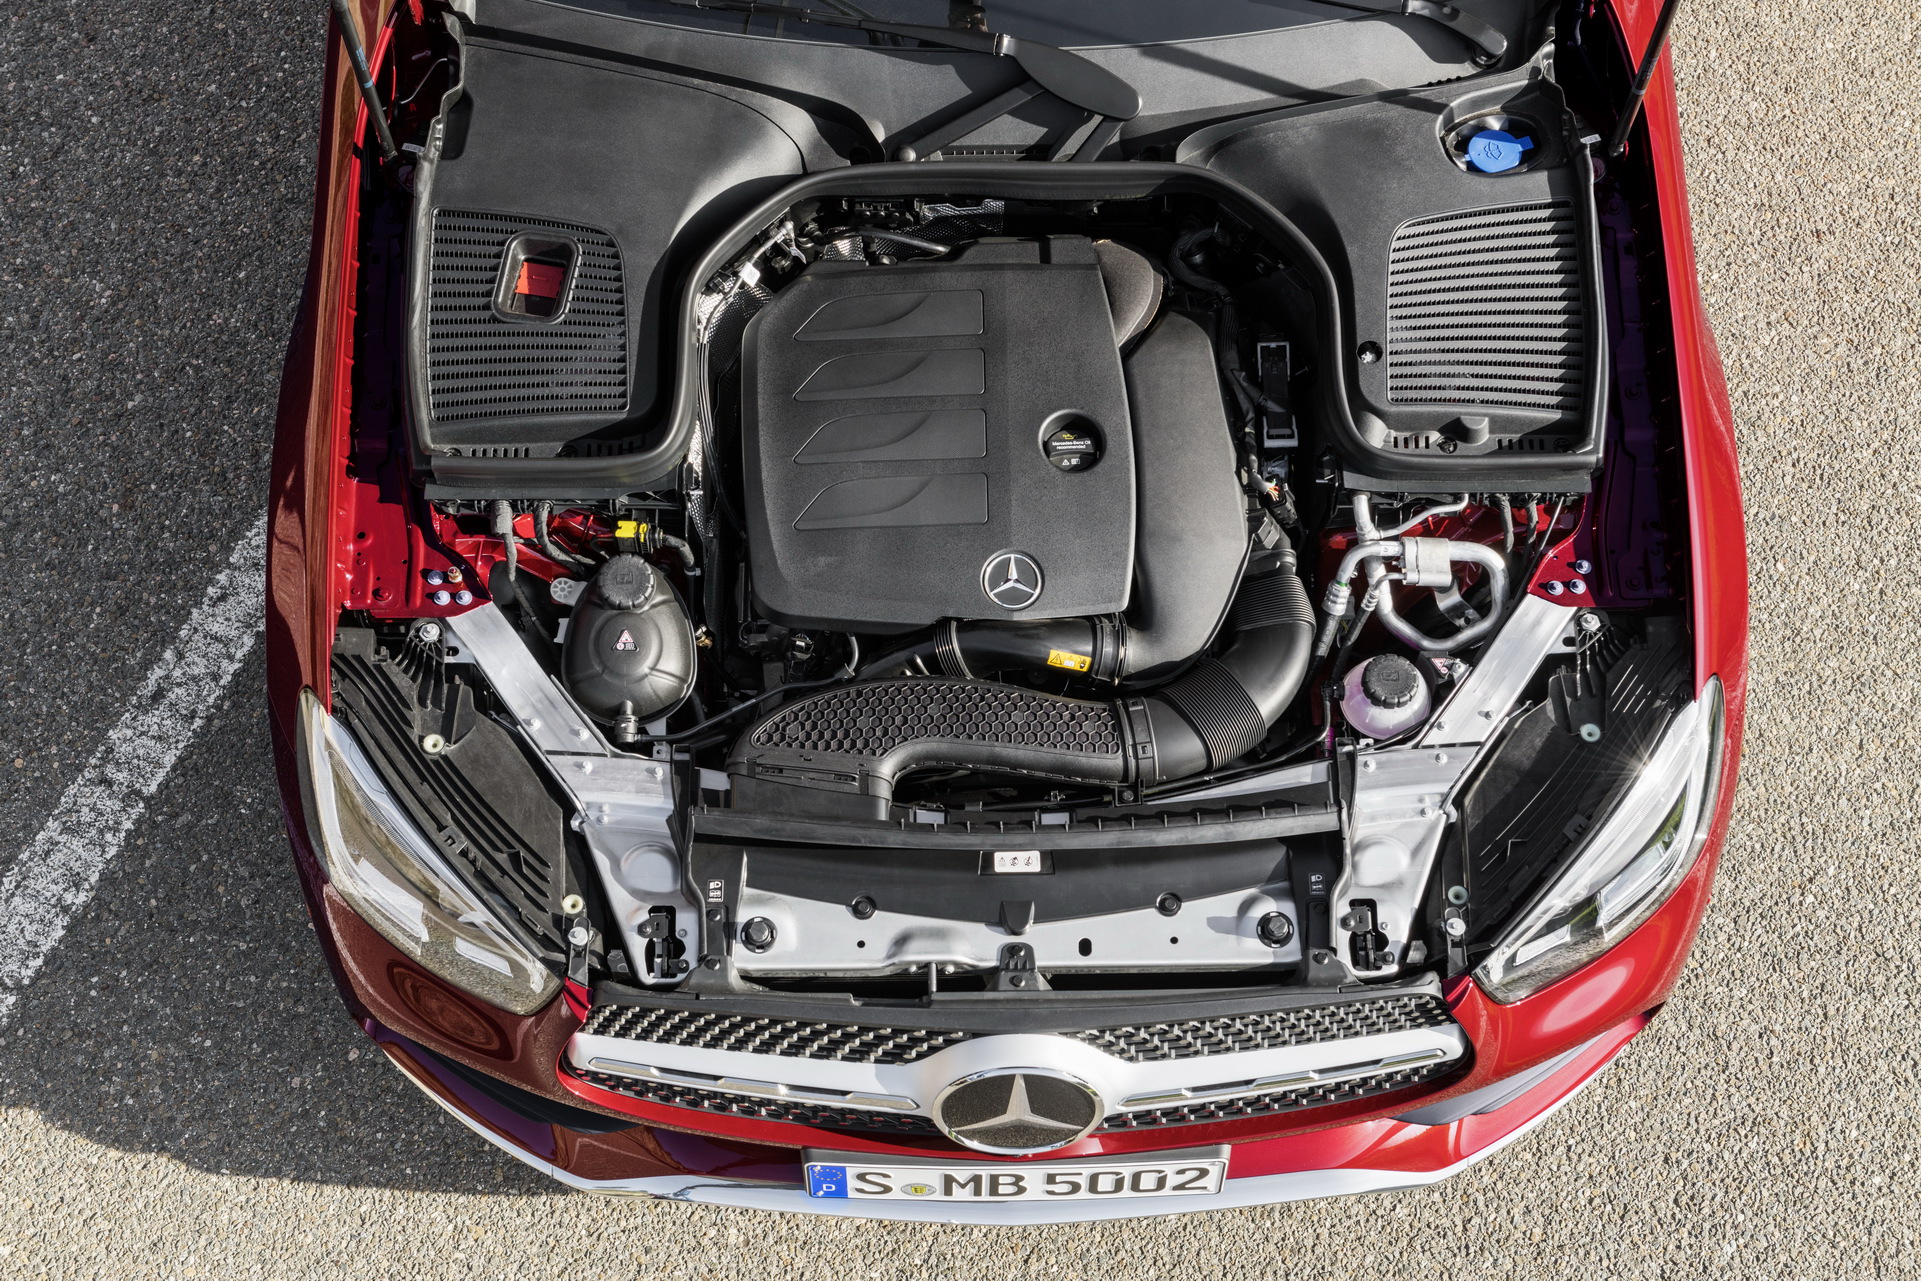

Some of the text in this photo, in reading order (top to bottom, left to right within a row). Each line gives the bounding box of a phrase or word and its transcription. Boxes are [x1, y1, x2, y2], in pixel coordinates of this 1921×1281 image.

[822, 1184, 836, 1192] D
[854, 1167, 1211, 1197] S MB 5002
